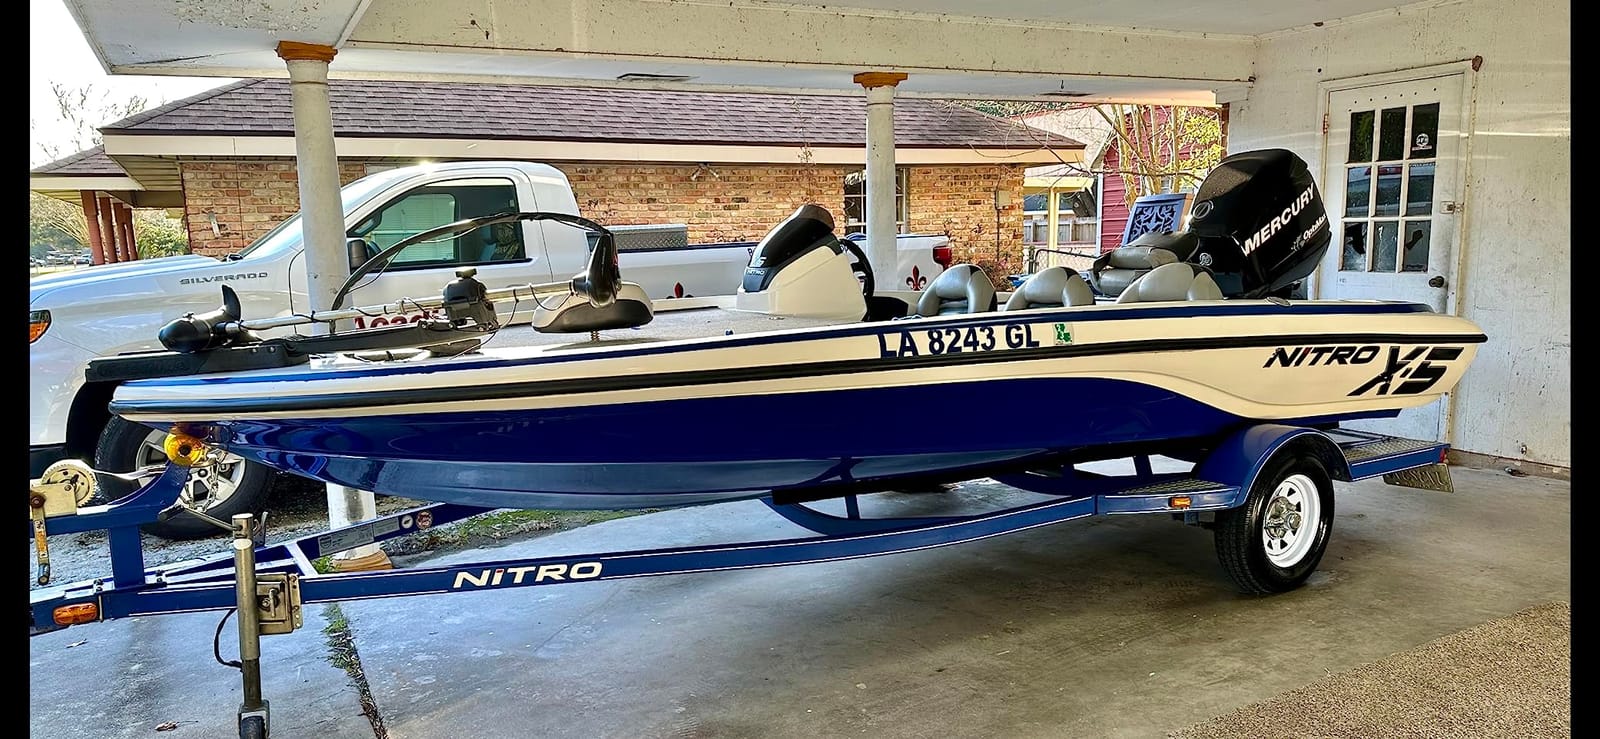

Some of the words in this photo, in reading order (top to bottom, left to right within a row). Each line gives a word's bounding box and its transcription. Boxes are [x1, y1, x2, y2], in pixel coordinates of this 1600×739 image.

[1241, 182, 1314, 256] MERCURY
[179, 272, 268, 285] SILVERADO
[877, 330, 920, 359] LA
[927, 326, 996, 355] 8243
[1005, 324, 1040, 349] GL
[1263, 346, 1381, 368] NITRO
